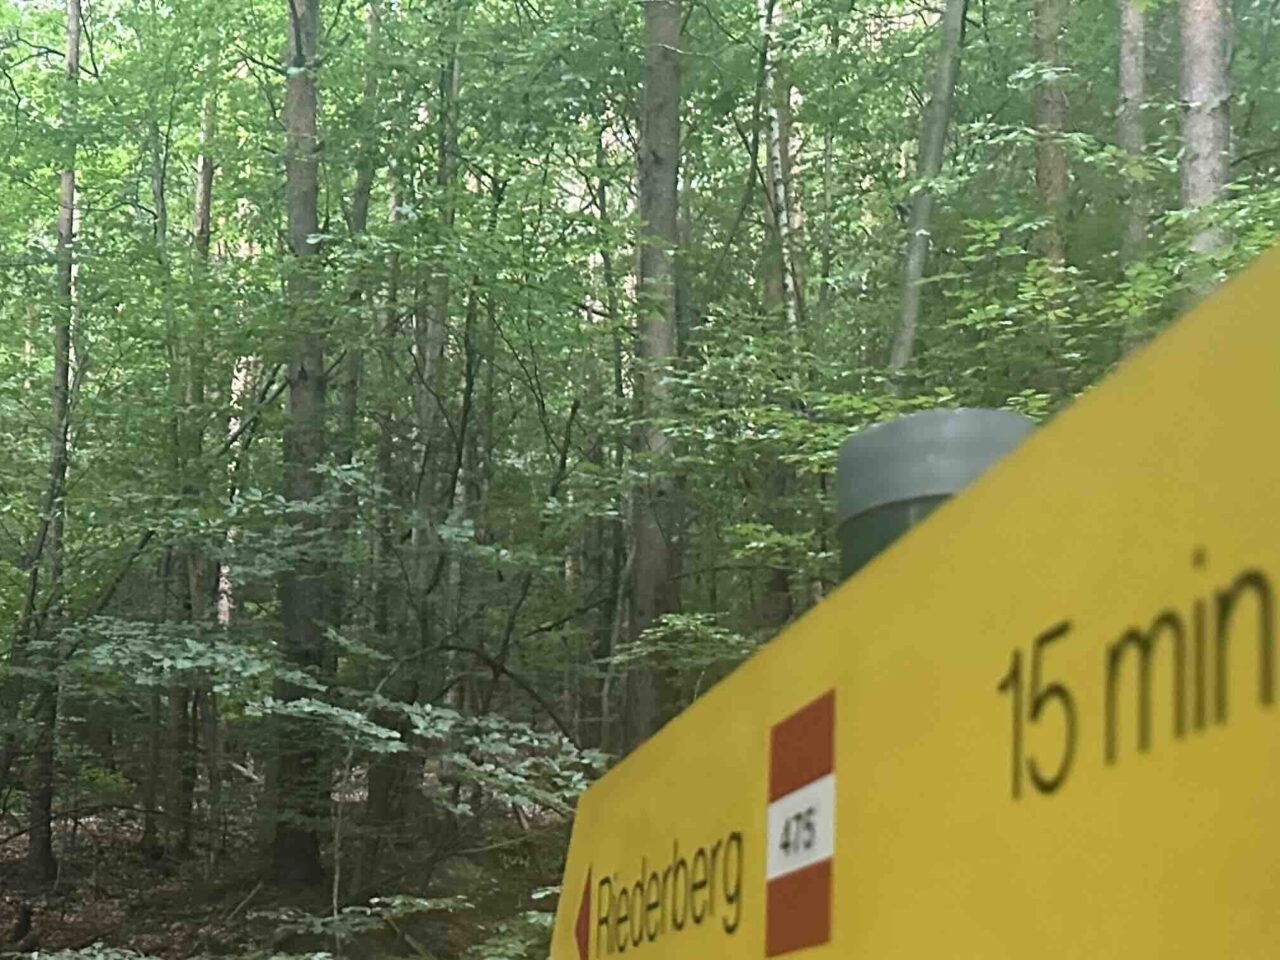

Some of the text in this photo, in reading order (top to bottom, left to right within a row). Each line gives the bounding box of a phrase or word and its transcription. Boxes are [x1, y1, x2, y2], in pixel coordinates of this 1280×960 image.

[997, 545, 1277, 803] 15 min
[595, 830, 744, 959] Riederberg
[779, 805, 817, 857] 475
